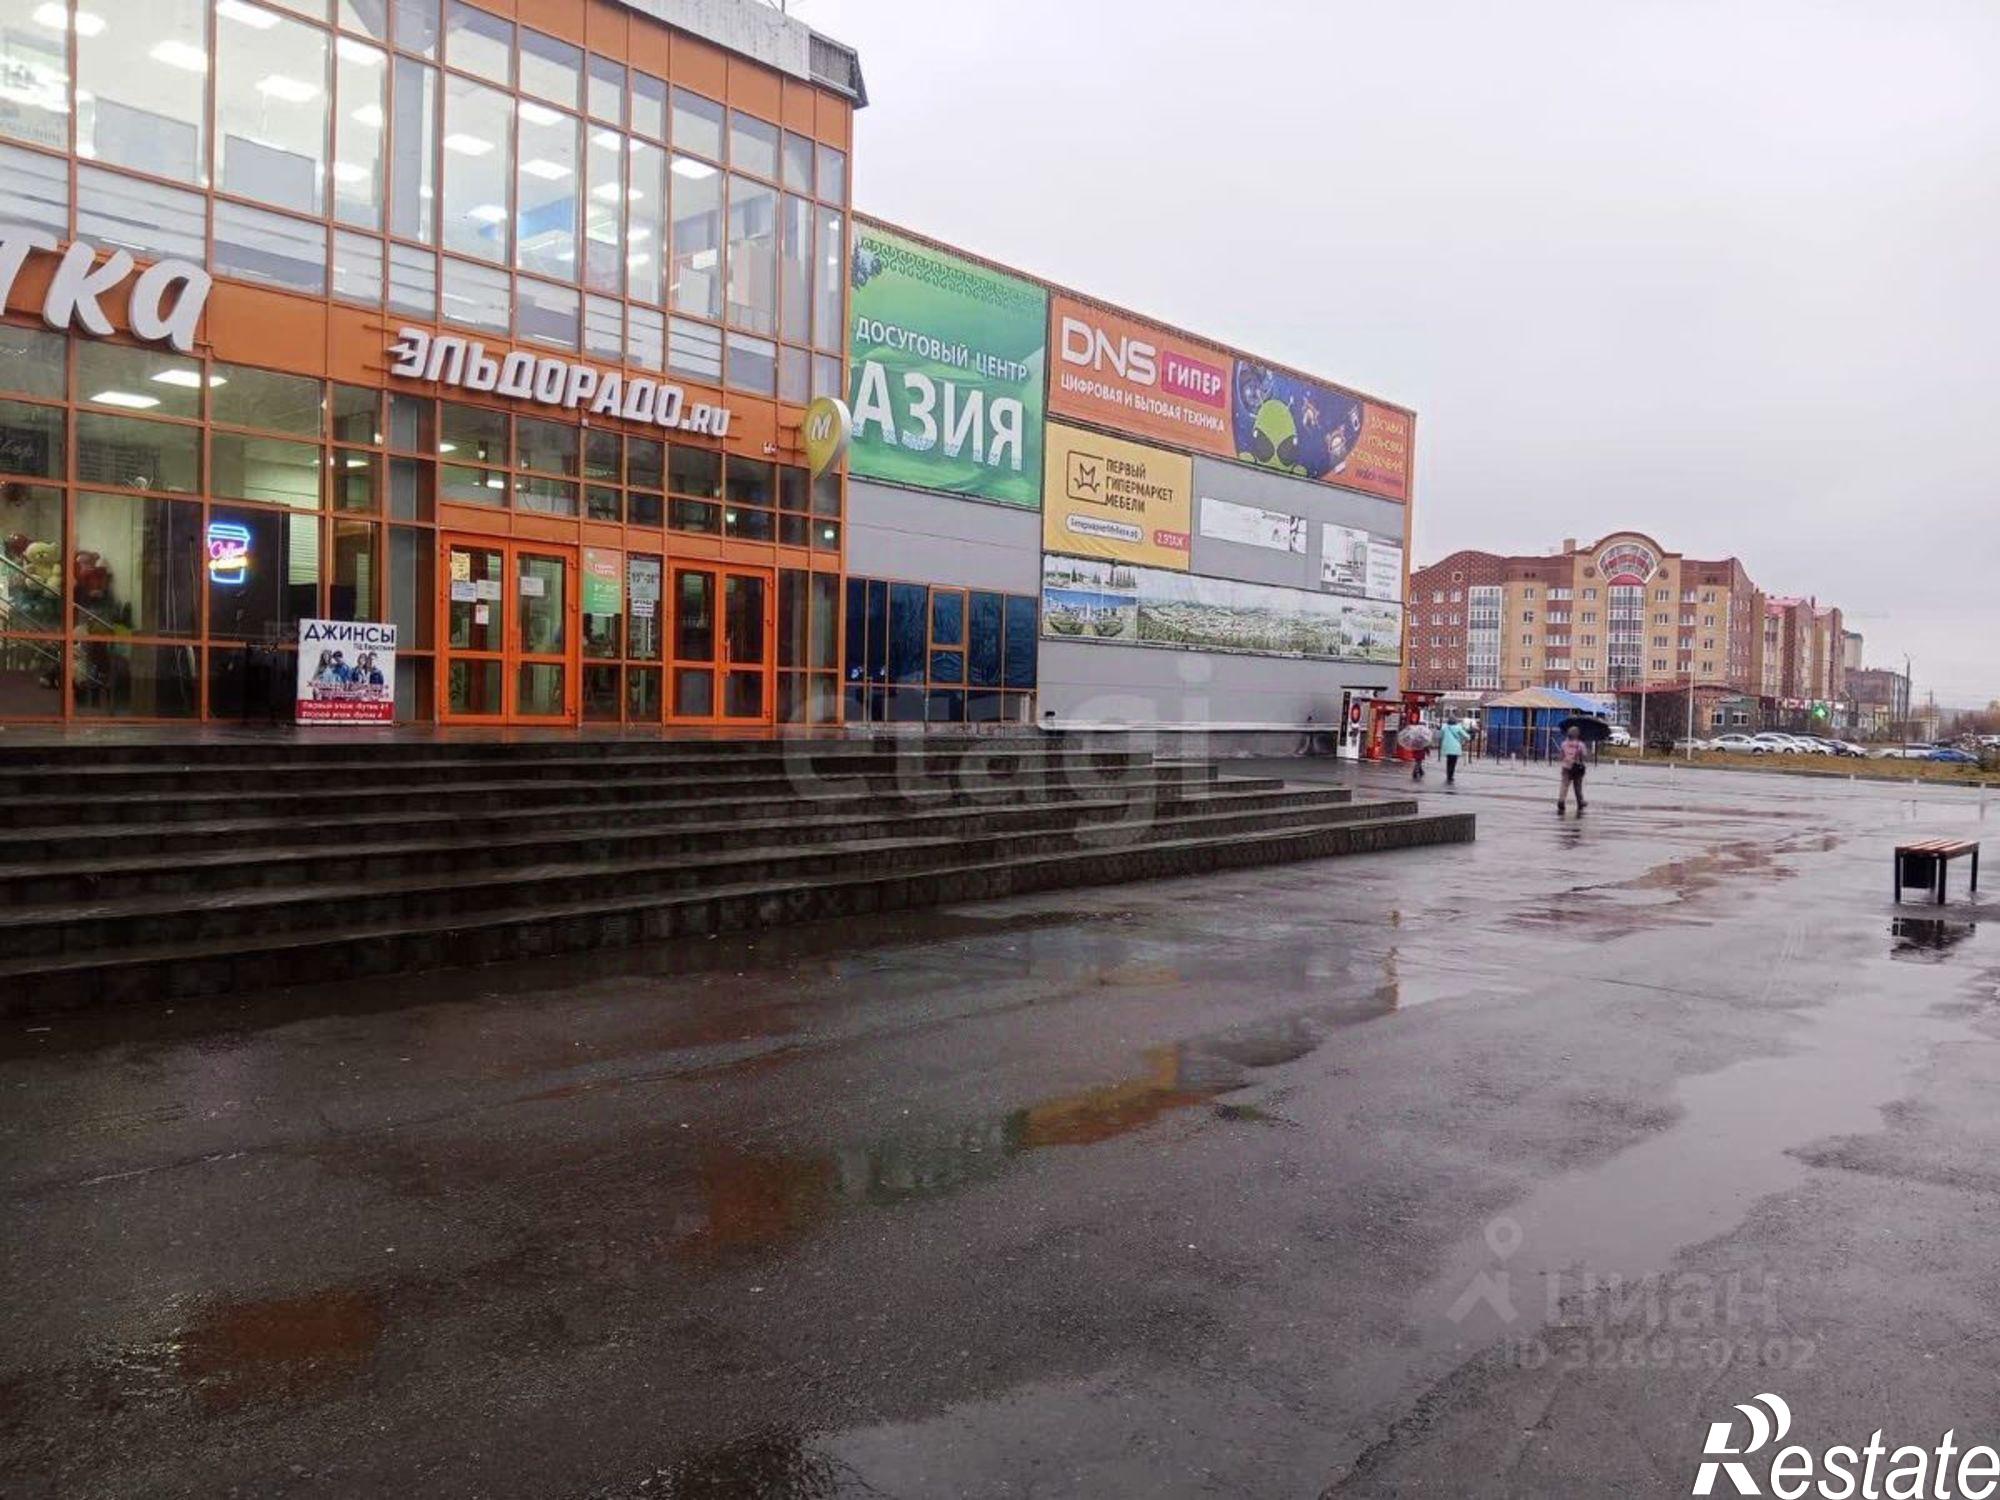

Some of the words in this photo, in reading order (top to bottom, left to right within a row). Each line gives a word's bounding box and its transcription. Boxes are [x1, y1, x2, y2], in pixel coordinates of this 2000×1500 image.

[856, 315, 968, 368] ДОСУГОВЫЙ
[976, 351, 1028, 382] ЦЕНТР
[1061, 316, 1157, 386] DNS
[1167, 361, 1221, 396] ГИПЕР
[851, 359, 1023, 471] АЗИЯ
[1061, 373, 1123, 404] ЦИФРОВАЯ
[1124, 390, 1133, 407] И
[1134, 394, 1182, 420] БЫТОВАЯ
[1183, 408, 1225, 432] ТЕХНИКА
[1106, 458, 1146, 480] ПЕРВЫЙ
[1105, 492, 1146, 513] МЕБЕЛИ
[1106, 476, 1174, 502] ГИПЕРМАРКЕТ
[304, 623, 394, 644] ДЖИНСЫ
